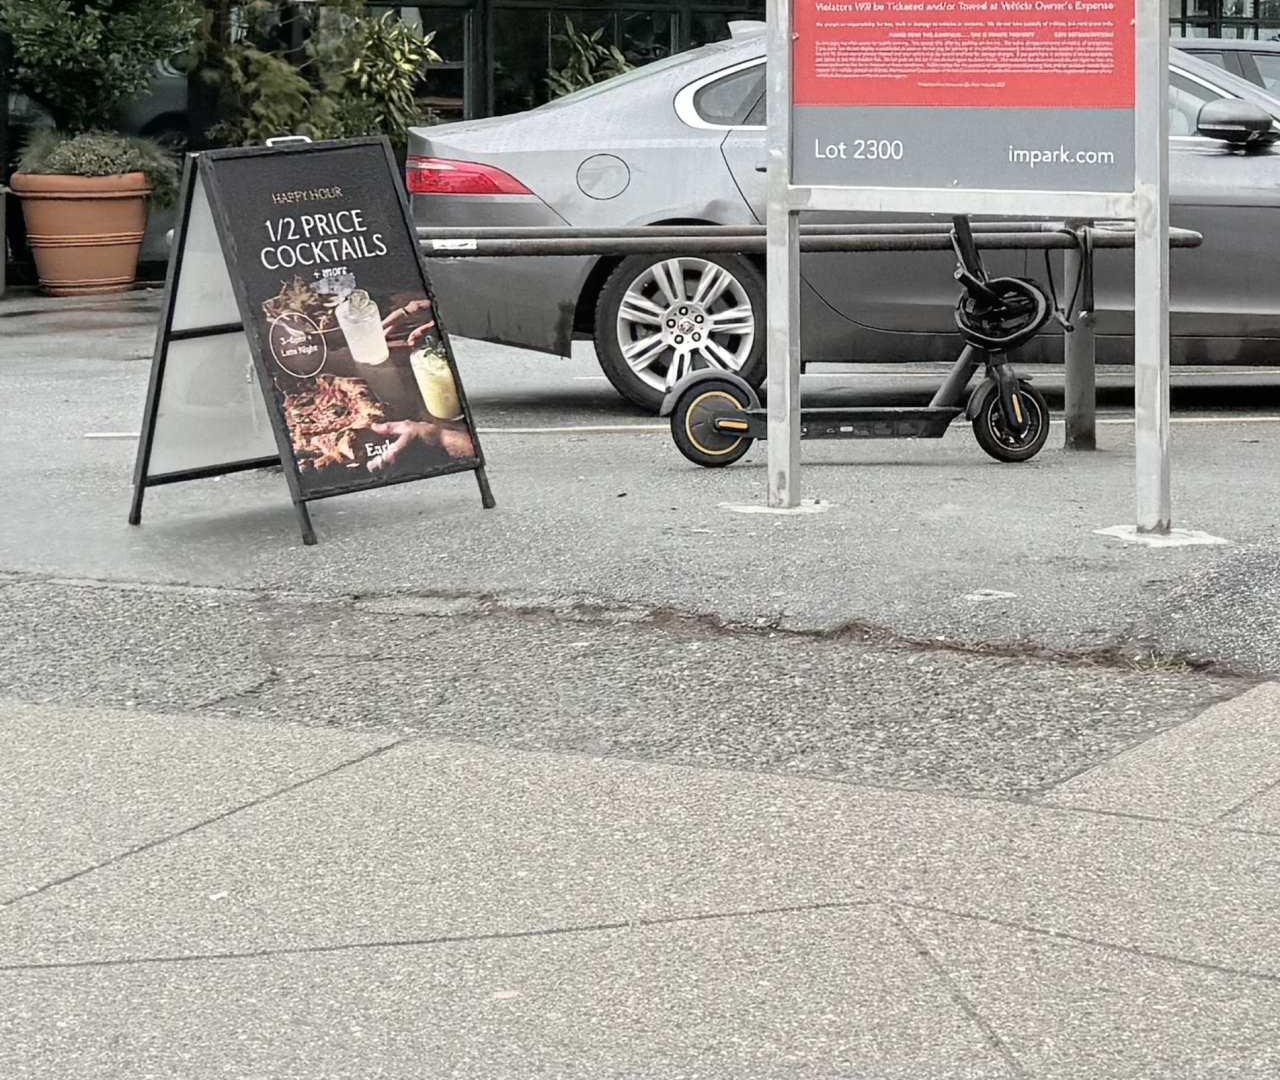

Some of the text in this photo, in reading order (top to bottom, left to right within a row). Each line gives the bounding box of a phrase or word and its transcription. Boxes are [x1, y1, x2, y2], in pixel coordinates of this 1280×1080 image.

[814, 138, 1115, 168] Lot 2300 impark.com
[272, 186, 344, 205] HAPPY HOUR
[264, 209, 368, 242] 1/2 PRICE
[260, 233, 388, 270] COCKTAILS
[321, 266, 348, 278] more
[364, 438, 396, 457] Earl
